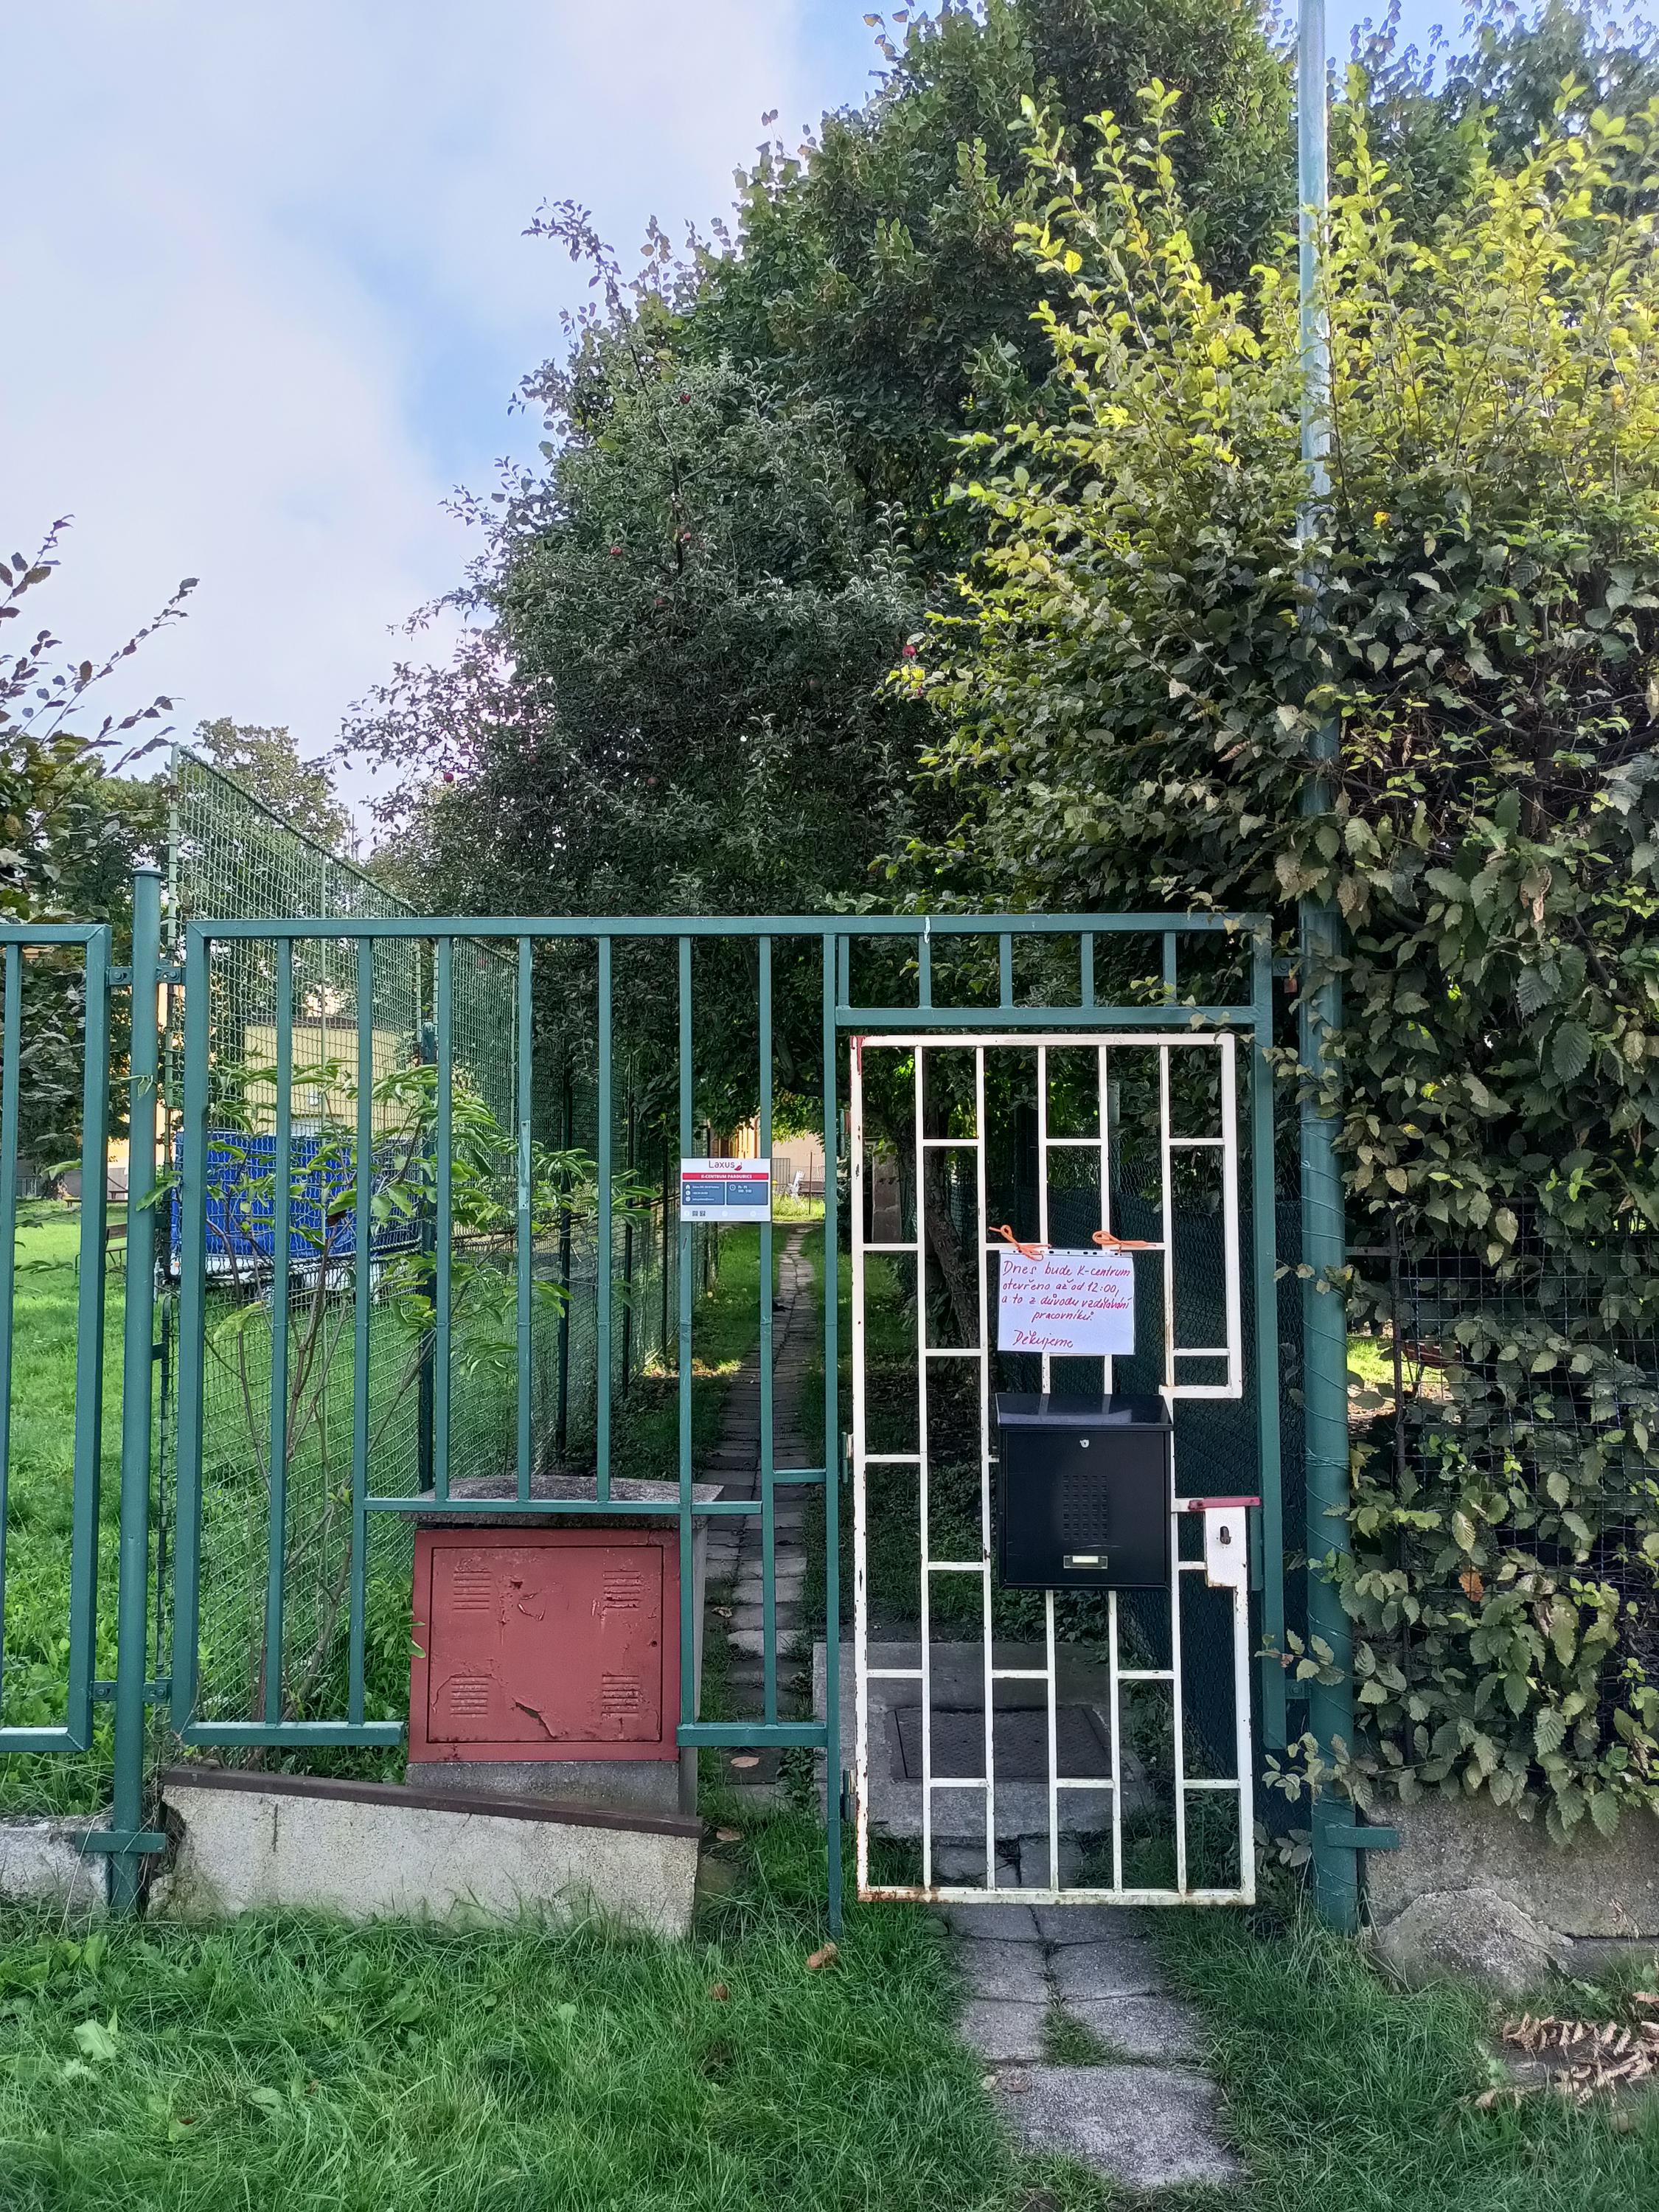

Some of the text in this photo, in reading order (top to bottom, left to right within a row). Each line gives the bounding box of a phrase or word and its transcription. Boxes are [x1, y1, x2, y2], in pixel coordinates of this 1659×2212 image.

[709, 1160, 735, 1169] Laxus
[1003, 1260, 1130, 1277] Dnes bude K-centrum
[1002, 1279, 1120, 1298] otevřeno až od 12:00,
[1001, 1295, 1008, 1304] a
[1013, 1293, 1023, 1304] to
[1040, 1293, 1079, 1306] důvodu
[1012, 1329, 1074, 1350] Děkujeme
